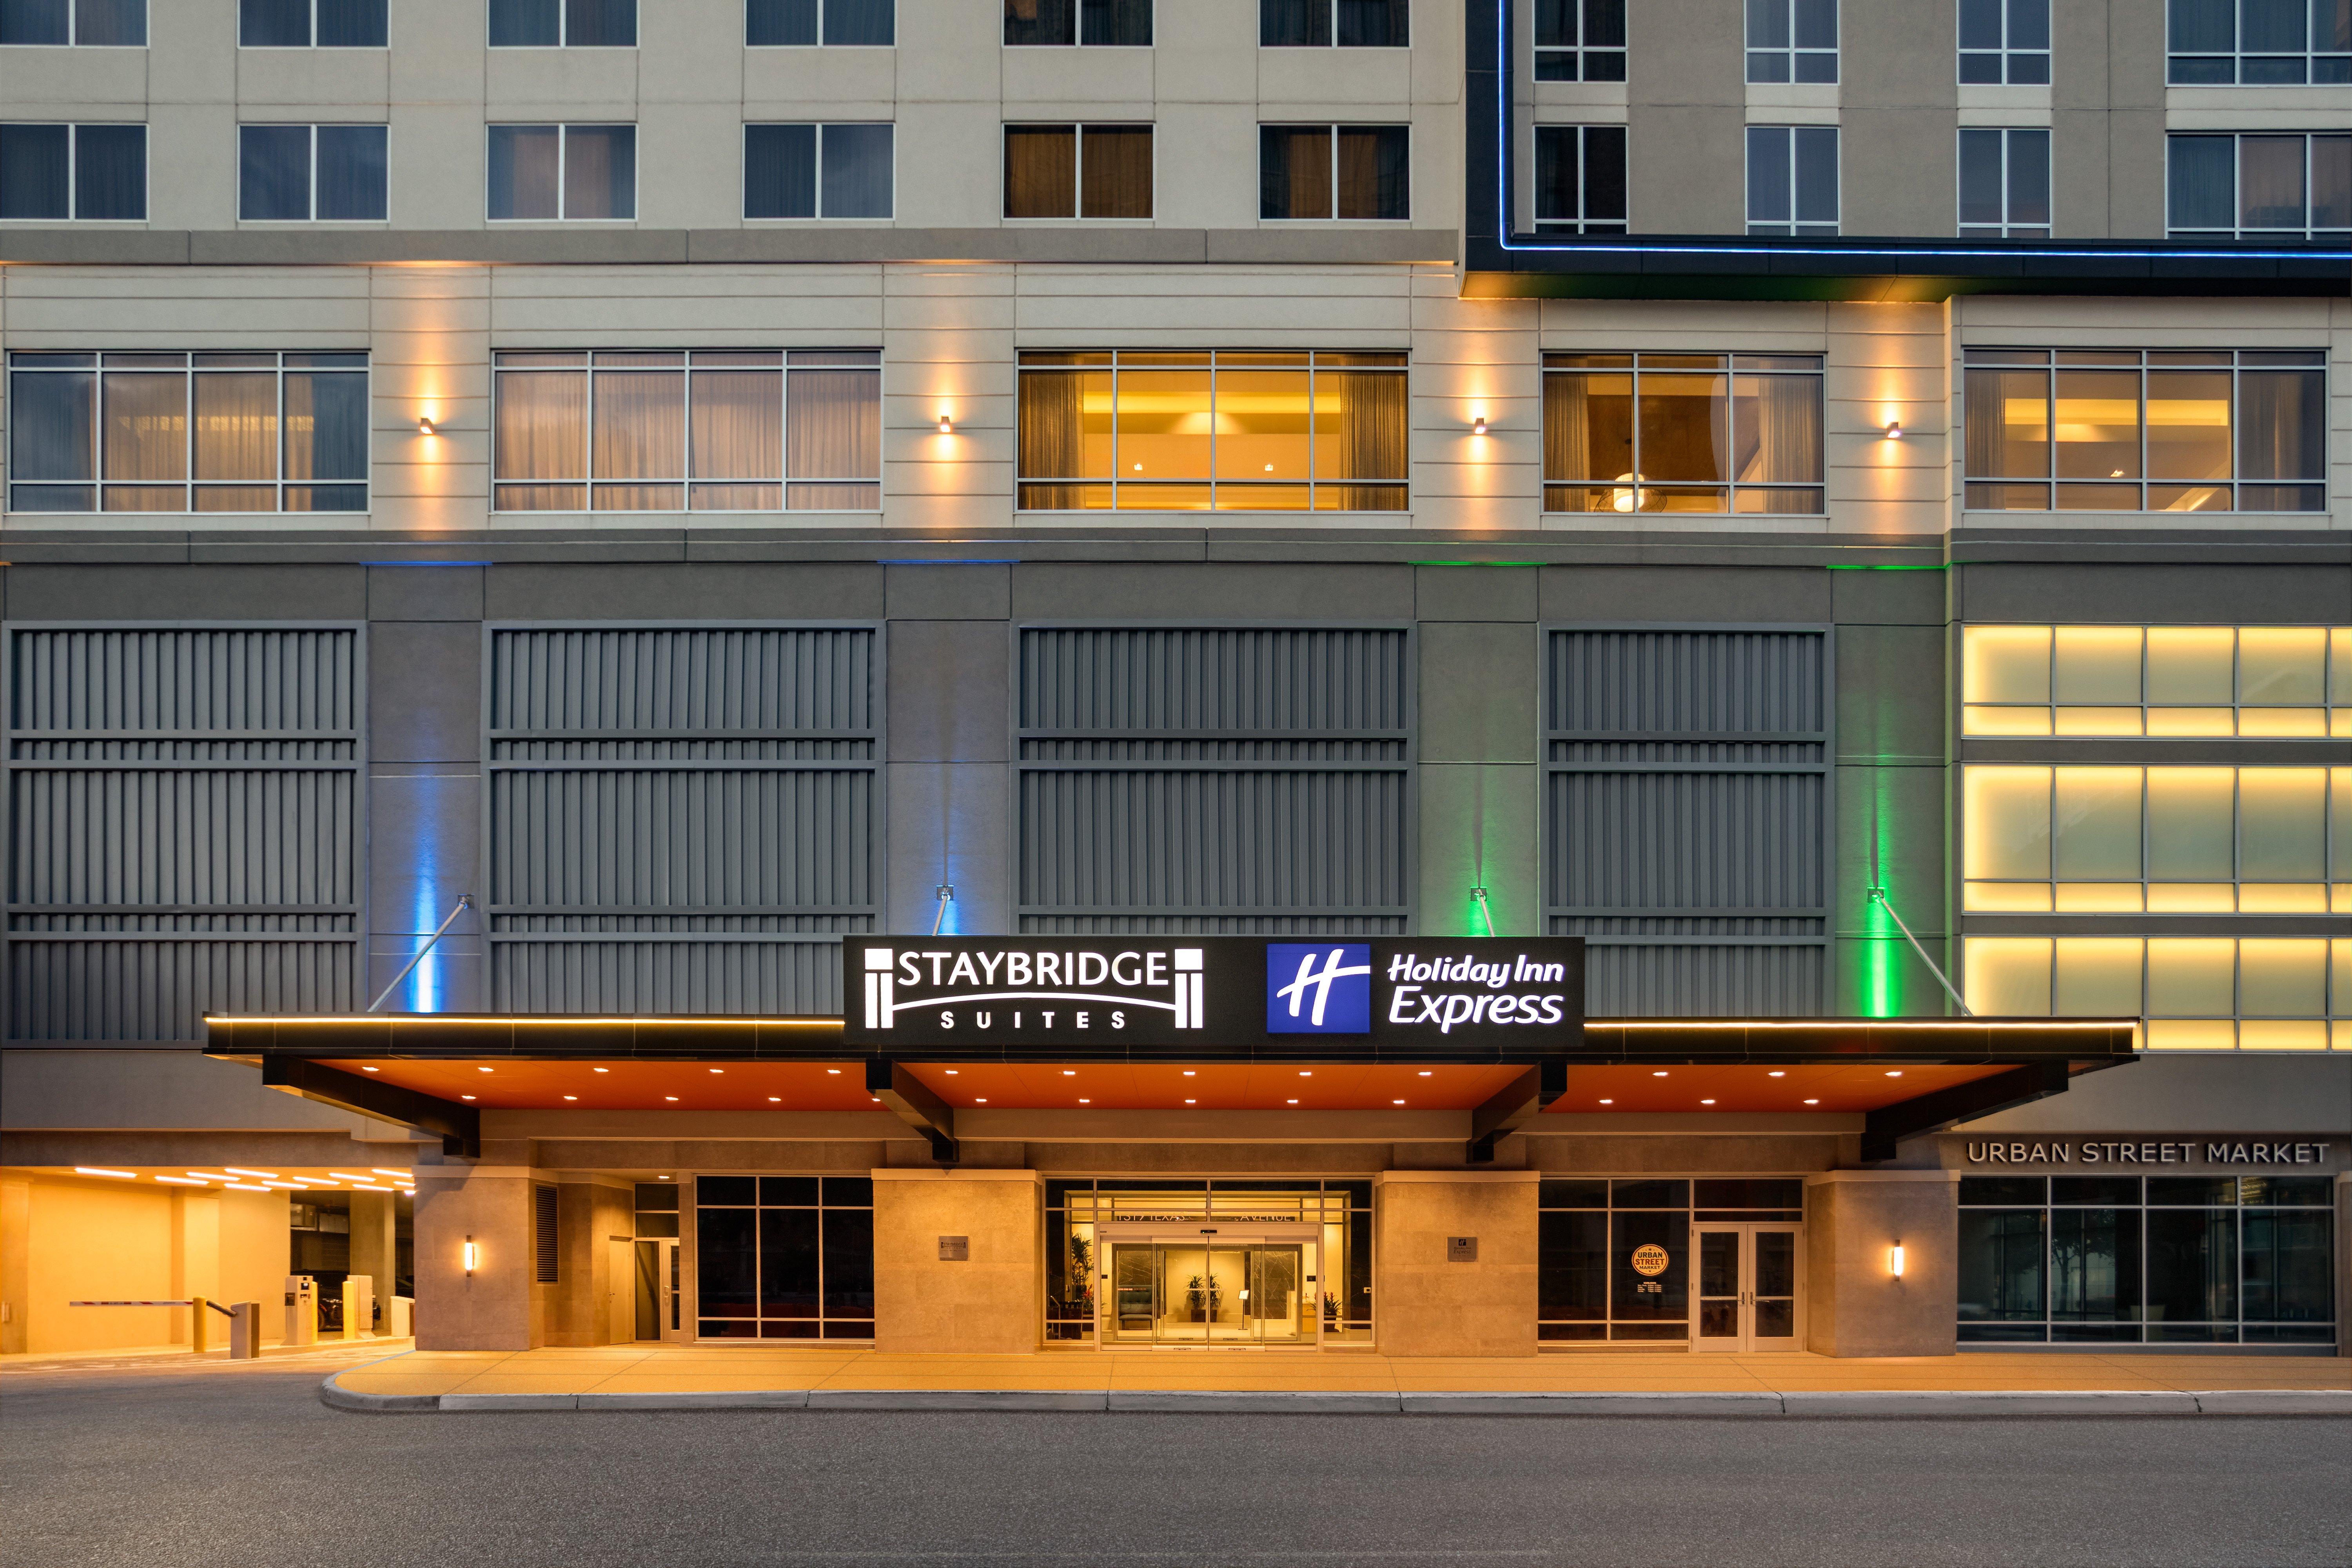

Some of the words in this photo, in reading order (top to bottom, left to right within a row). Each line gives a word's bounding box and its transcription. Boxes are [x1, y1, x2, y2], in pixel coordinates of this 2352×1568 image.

[897, 951, 1169, 986] STAYBRIDGE
[1387, 954, 1511, 988] Holiday
[1514, 954, 1564, 982] Inn
[940, 1011, 1125, 1029] SUITES
[1388, 985, 1564, 1034] Express
[1968, 1142, 2069, 1162] URBAN
[2081, 1142, 2196, 1162] STREET
[2207, 1143, 2330, 1163] MARKET
[1149, 1212, 1185, 1221] TEXAS
[1240, 1212, 1291, 1221] AVENUE
